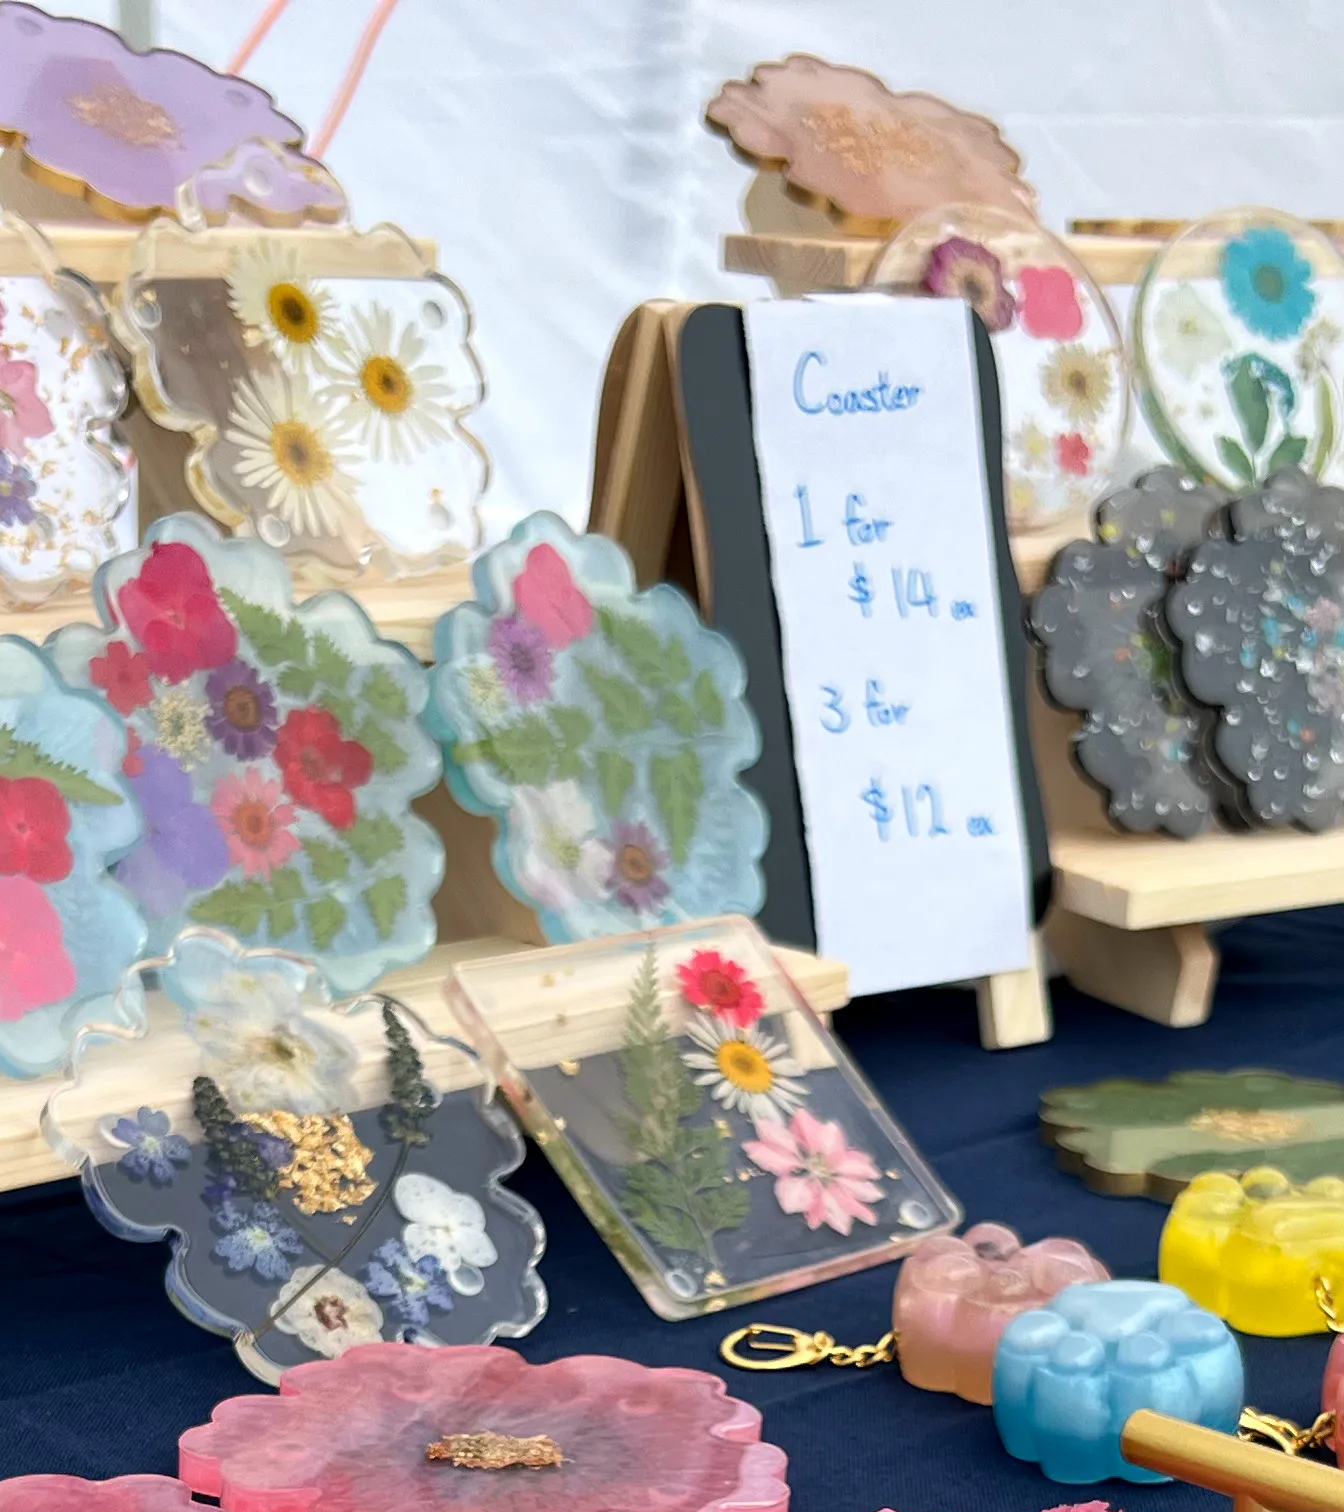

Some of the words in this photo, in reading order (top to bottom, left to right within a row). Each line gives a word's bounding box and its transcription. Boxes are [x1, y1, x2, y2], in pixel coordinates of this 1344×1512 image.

[793, 350, 924, 416] Coaster
[795, 484, 825, 549] 1
[842, 492, 894, 546] for
[819, 684, 851, 734] 3
[863, 678, 911, 727] for
